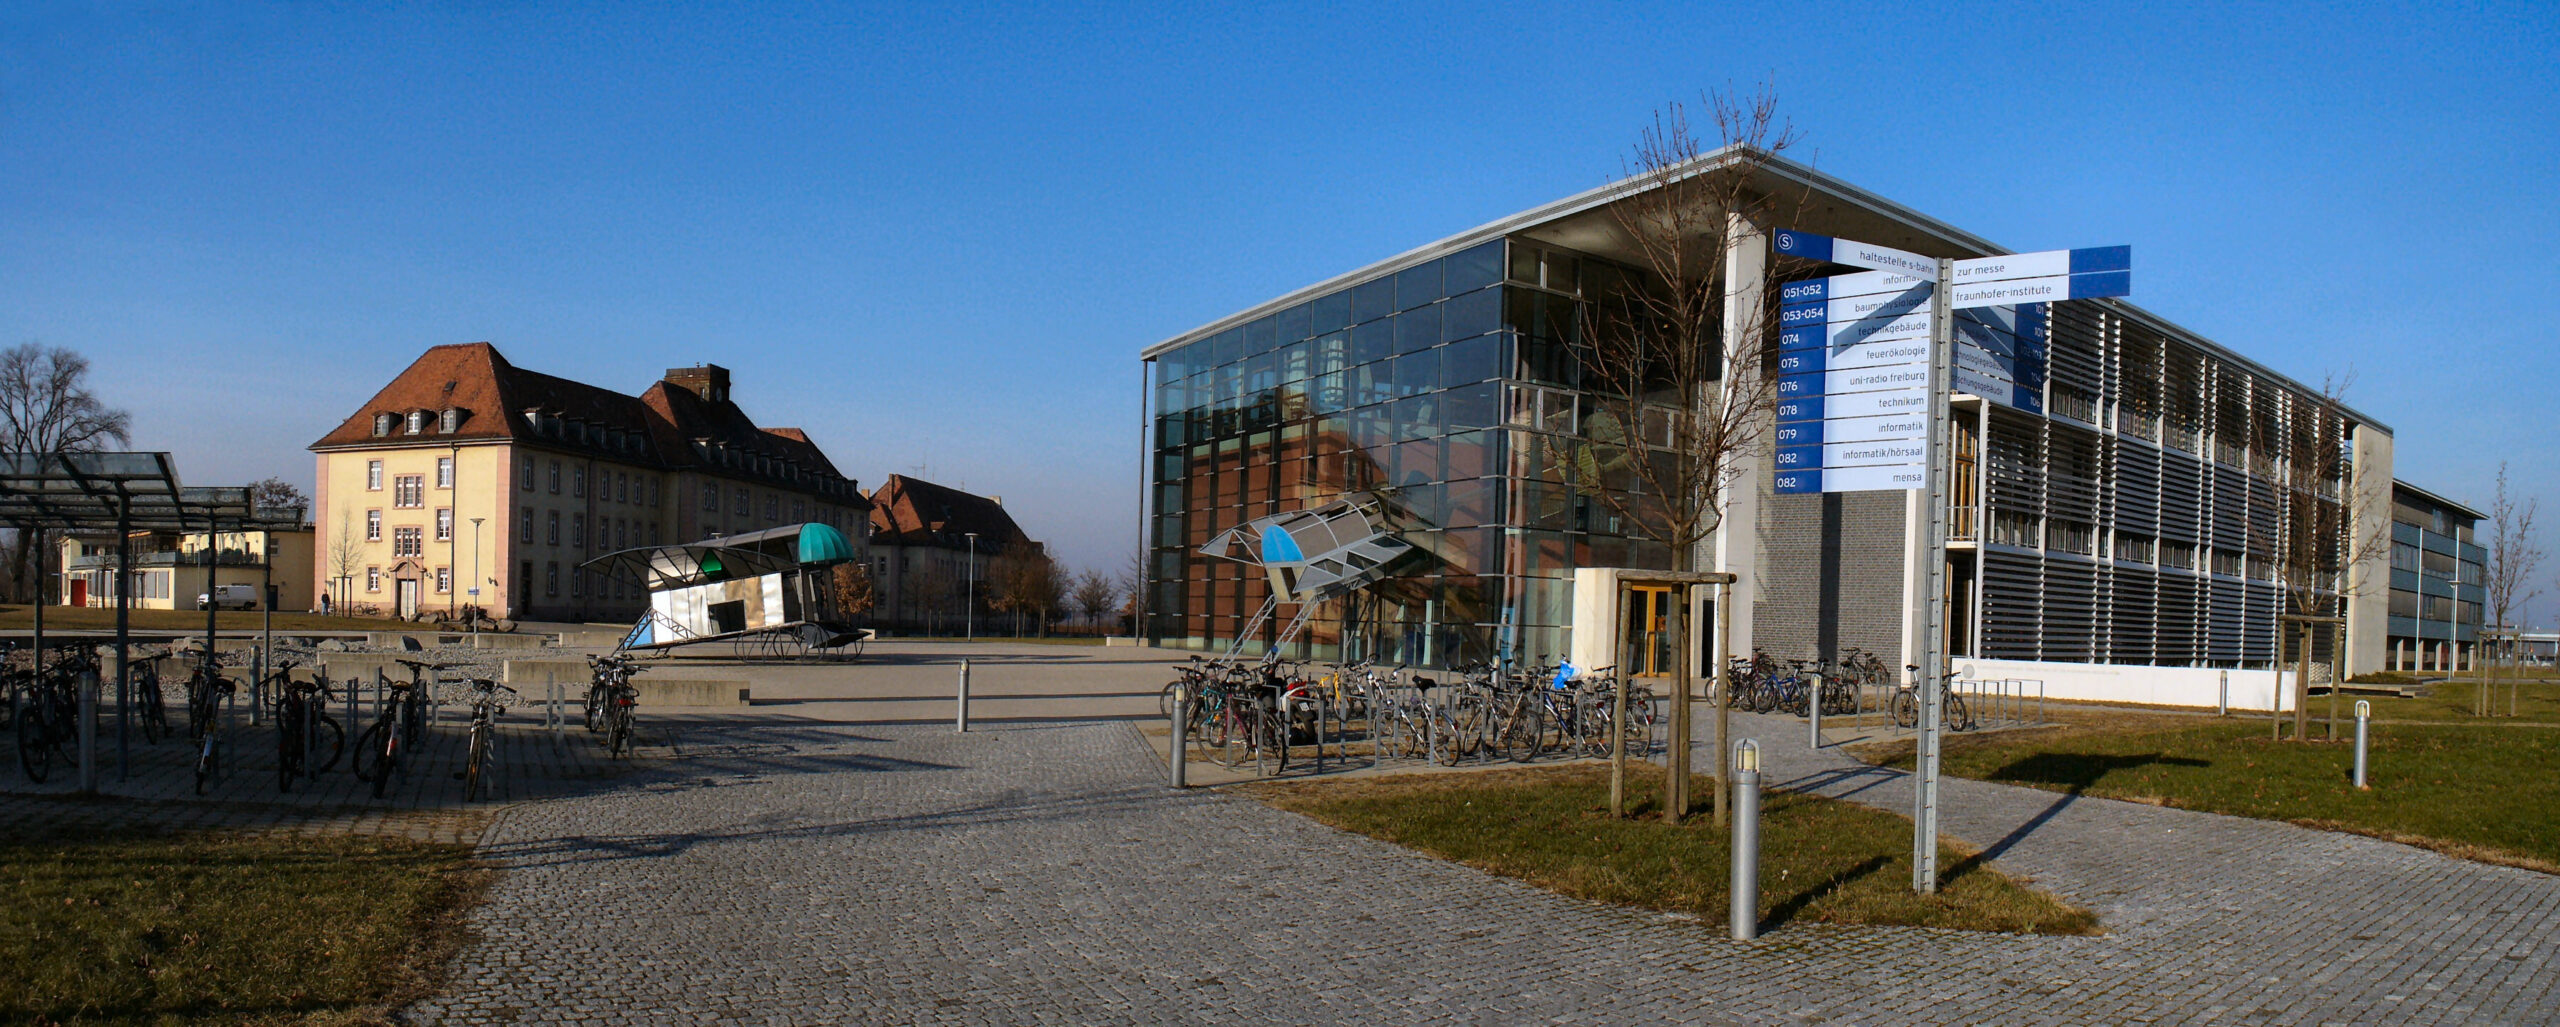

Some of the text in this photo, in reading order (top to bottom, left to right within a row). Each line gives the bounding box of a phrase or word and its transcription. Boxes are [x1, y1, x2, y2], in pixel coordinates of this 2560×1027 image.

[1859, 250, 1934, 275] haltestelle s-bahn
[1957, 264, 2005, 277] zur messe
[1883, 273, 1923, 285] informa
[1783, 283, 1822, 299] 051-052
[1956, 284, 2052, 302] fraunhofer-institute
[1855, 296, 1927, 313] baumphysiologie
[1782, 307, 1824, 322] 053-054
[1858, 320, 1927, 337] technikgebäude
[1781, 334, 1800, 345] 074
[1866, 346, 1926, 360] feuerökologie
[1780, 357, 1799, 369] 075
[1849, 371, 1925, 386] uni-radio freiburg
[1780, 381, 1798, 392] 076
[1879, 396, 1924, 408] technikum
[1779, 404, 1798, 416] 078
[1878, 421, 1923, 433] informatik
[1778, 428, 1797, 440] 079
[1777, 453, 1797, 464] 082
[1842, 446, 1923, 460] informatik/hörsaal
[1777, 477, 1796, 488] 082
[1893, 472, 1922, 482] mensa
